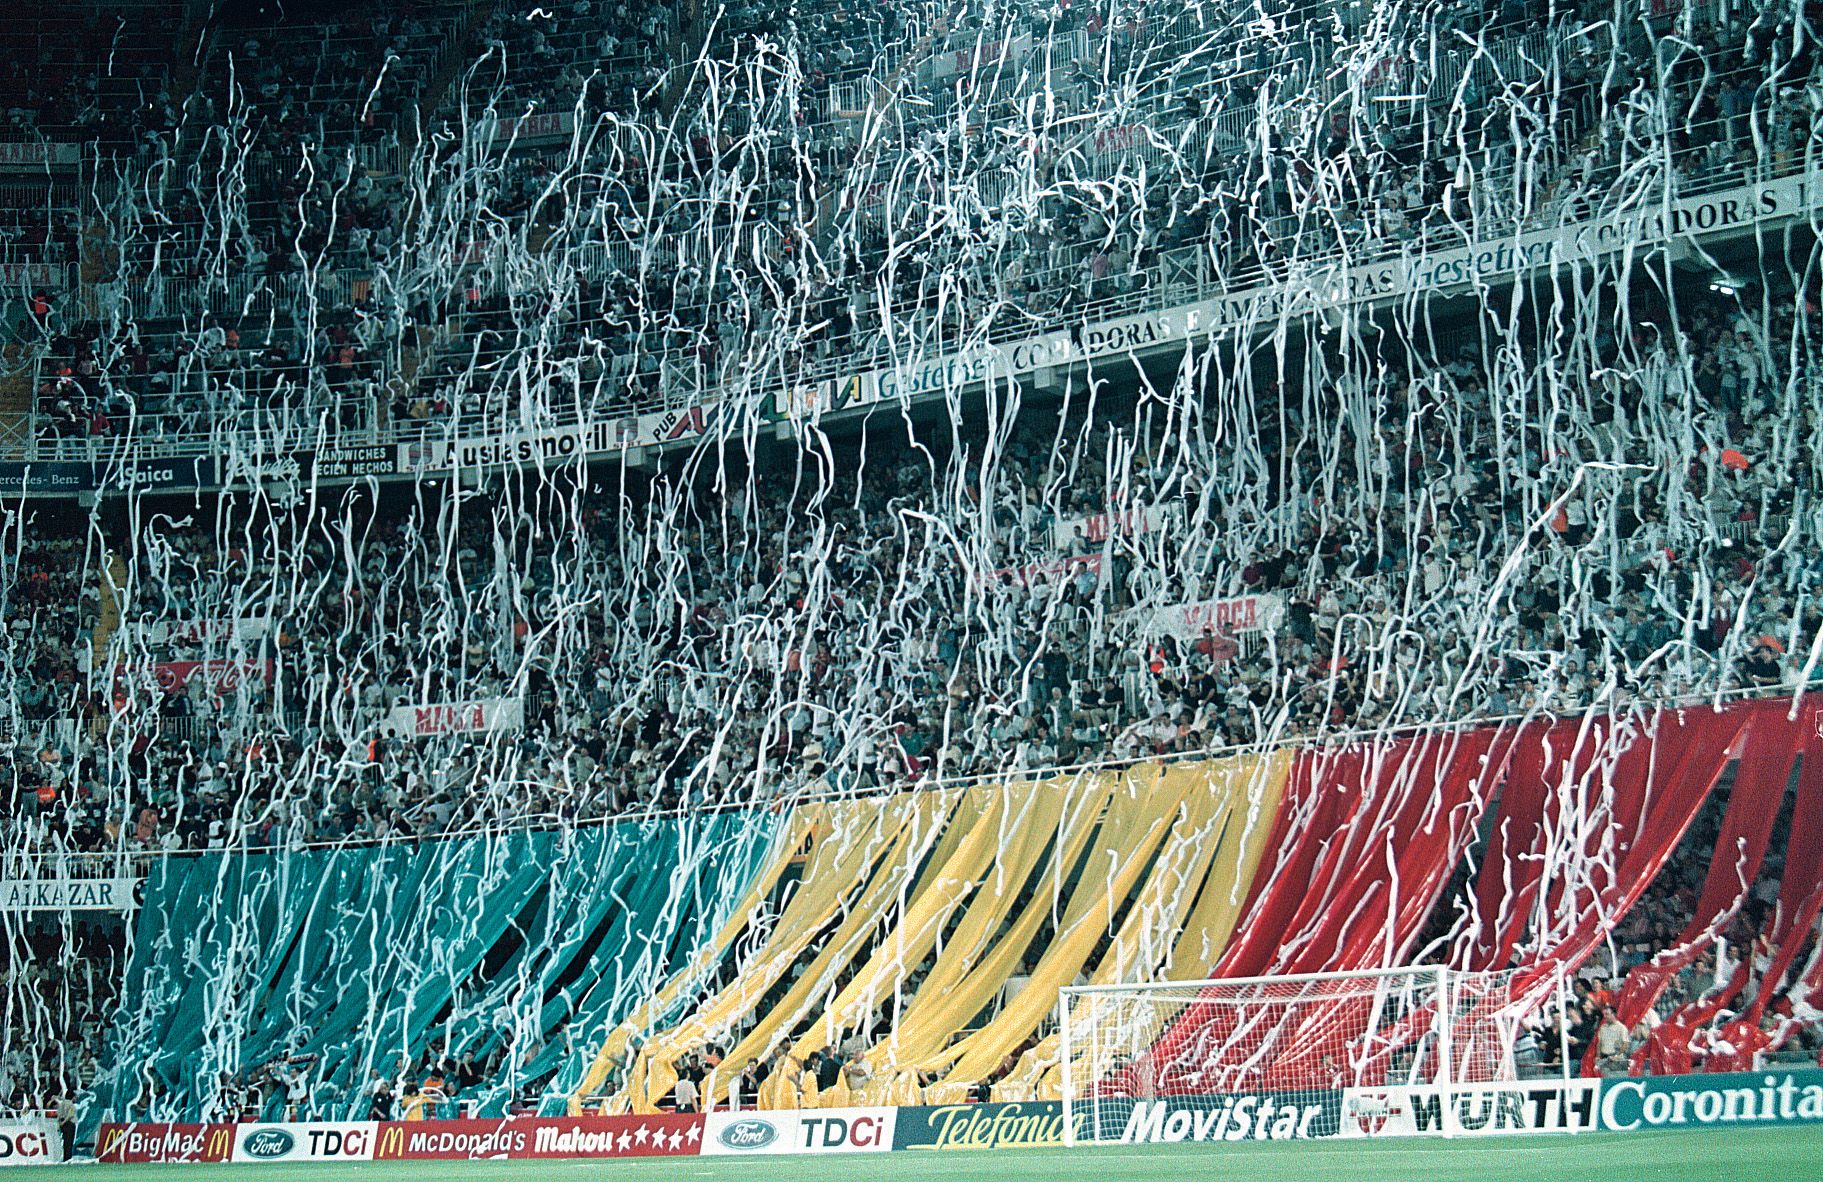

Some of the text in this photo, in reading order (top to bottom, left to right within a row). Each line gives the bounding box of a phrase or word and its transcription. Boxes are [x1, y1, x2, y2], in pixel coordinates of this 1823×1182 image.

[653, 412, 678, 441] PUB
[52, 475, 80, 485] Benz
[352, 460, 393, 475] HECHOS
[1601, 1074, 1823, 1131] Coronita
[731, 1116, 884, 1147] Ford TDCi
[1121, 1096, 1322, 1143] MoviStar
[251, 1129, 369, 1155] Ford TDCi
[408, 1130, 526, 1153] McDonald's
[534, 1126, 613, 1153] Mahou
